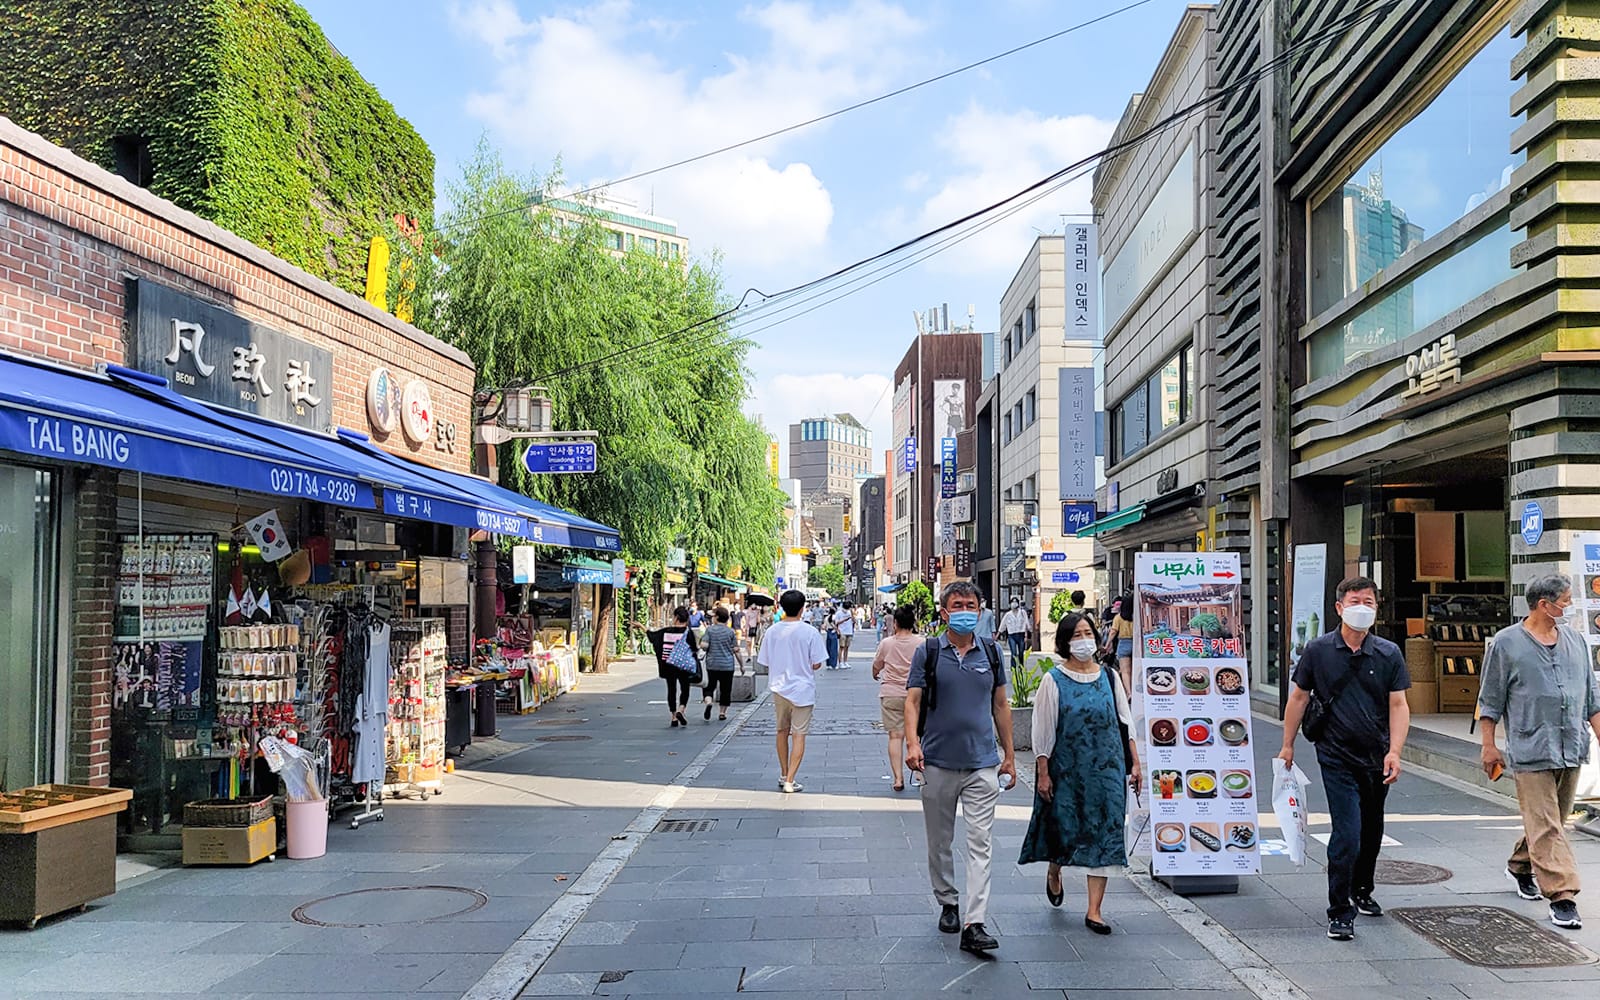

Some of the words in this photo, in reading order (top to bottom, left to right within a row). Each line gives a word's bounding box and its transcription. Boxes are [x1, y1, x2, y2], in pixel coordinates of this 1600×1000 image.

[1075, 227, 1088, 273] 갤러리
[1075, 284, 1088, 326] 인덱스
[175, 371, 195, 386] BEOM
[1400, 333, 1462, 399] 오설록
[240, 391, 256, 402] KOO
[1072, 374, 1085, 423] 도채비도
[295, 405, 306, 416] SA
[27, 415, 66, 453] TAL
[72, 424, 130, 463] BANG
[1068, 428, 1085, 454] 반한
[270, 467, 357, 503] 02)734-9289
[1072, 458, 1086, 488] 찻집
[395, 493, 432, 518] 범구사
[476, 510, 521, 534] 02)734-5527
[1524, 515, 1541, 531] ADT
[1153, 556, 1205, 581] 나무새
[1146, 636, 1206, 656] 전통한옥
[1211, 635, 1241, 656] 카페
